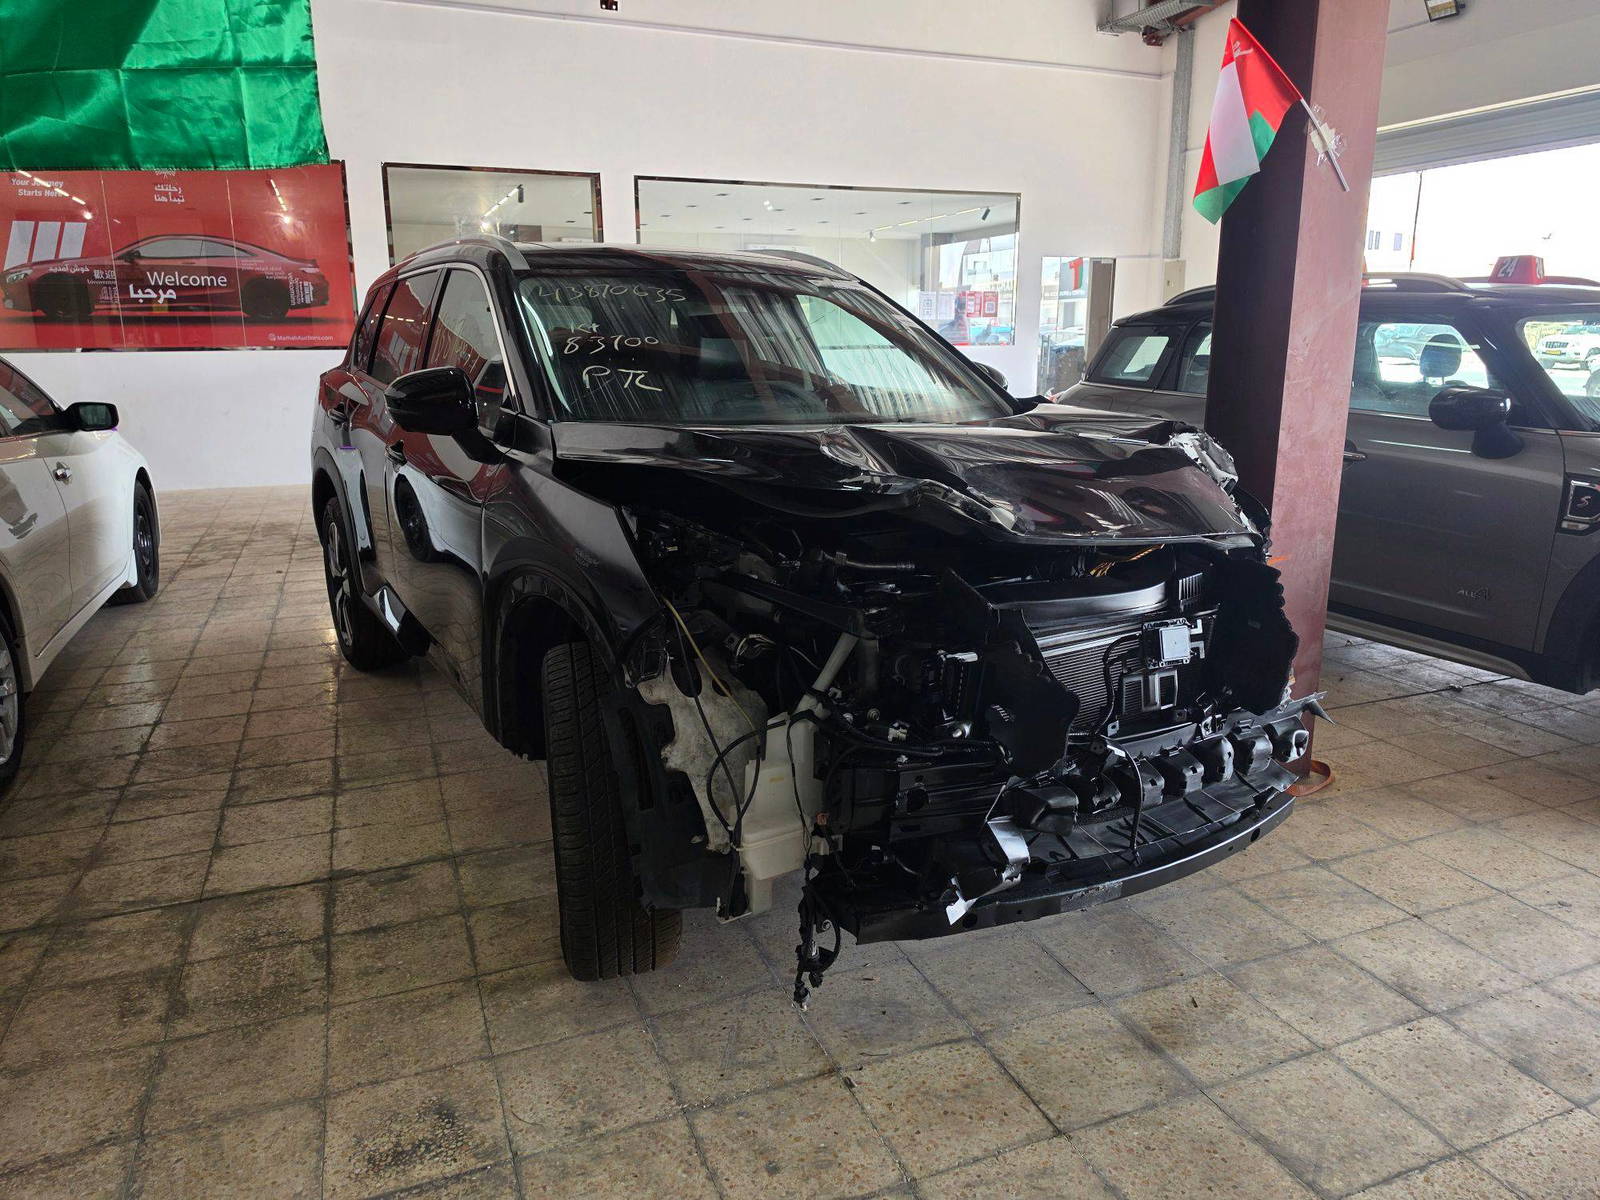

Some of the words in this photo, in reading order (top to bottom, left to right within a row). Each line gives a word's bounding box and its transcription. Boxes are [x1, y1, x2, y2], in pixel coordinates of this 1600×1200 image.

[11, 178, 29, 187] Your
[31, 179, 64, 189] Joney
[18, 189, 42, 197] Starts
[1496, 257, 1520, 278] 24
[146, 271, 228, 287] Welcome
[128, 283, 177, 304] مرحبا
[563, 335, 660, 354] 83700
